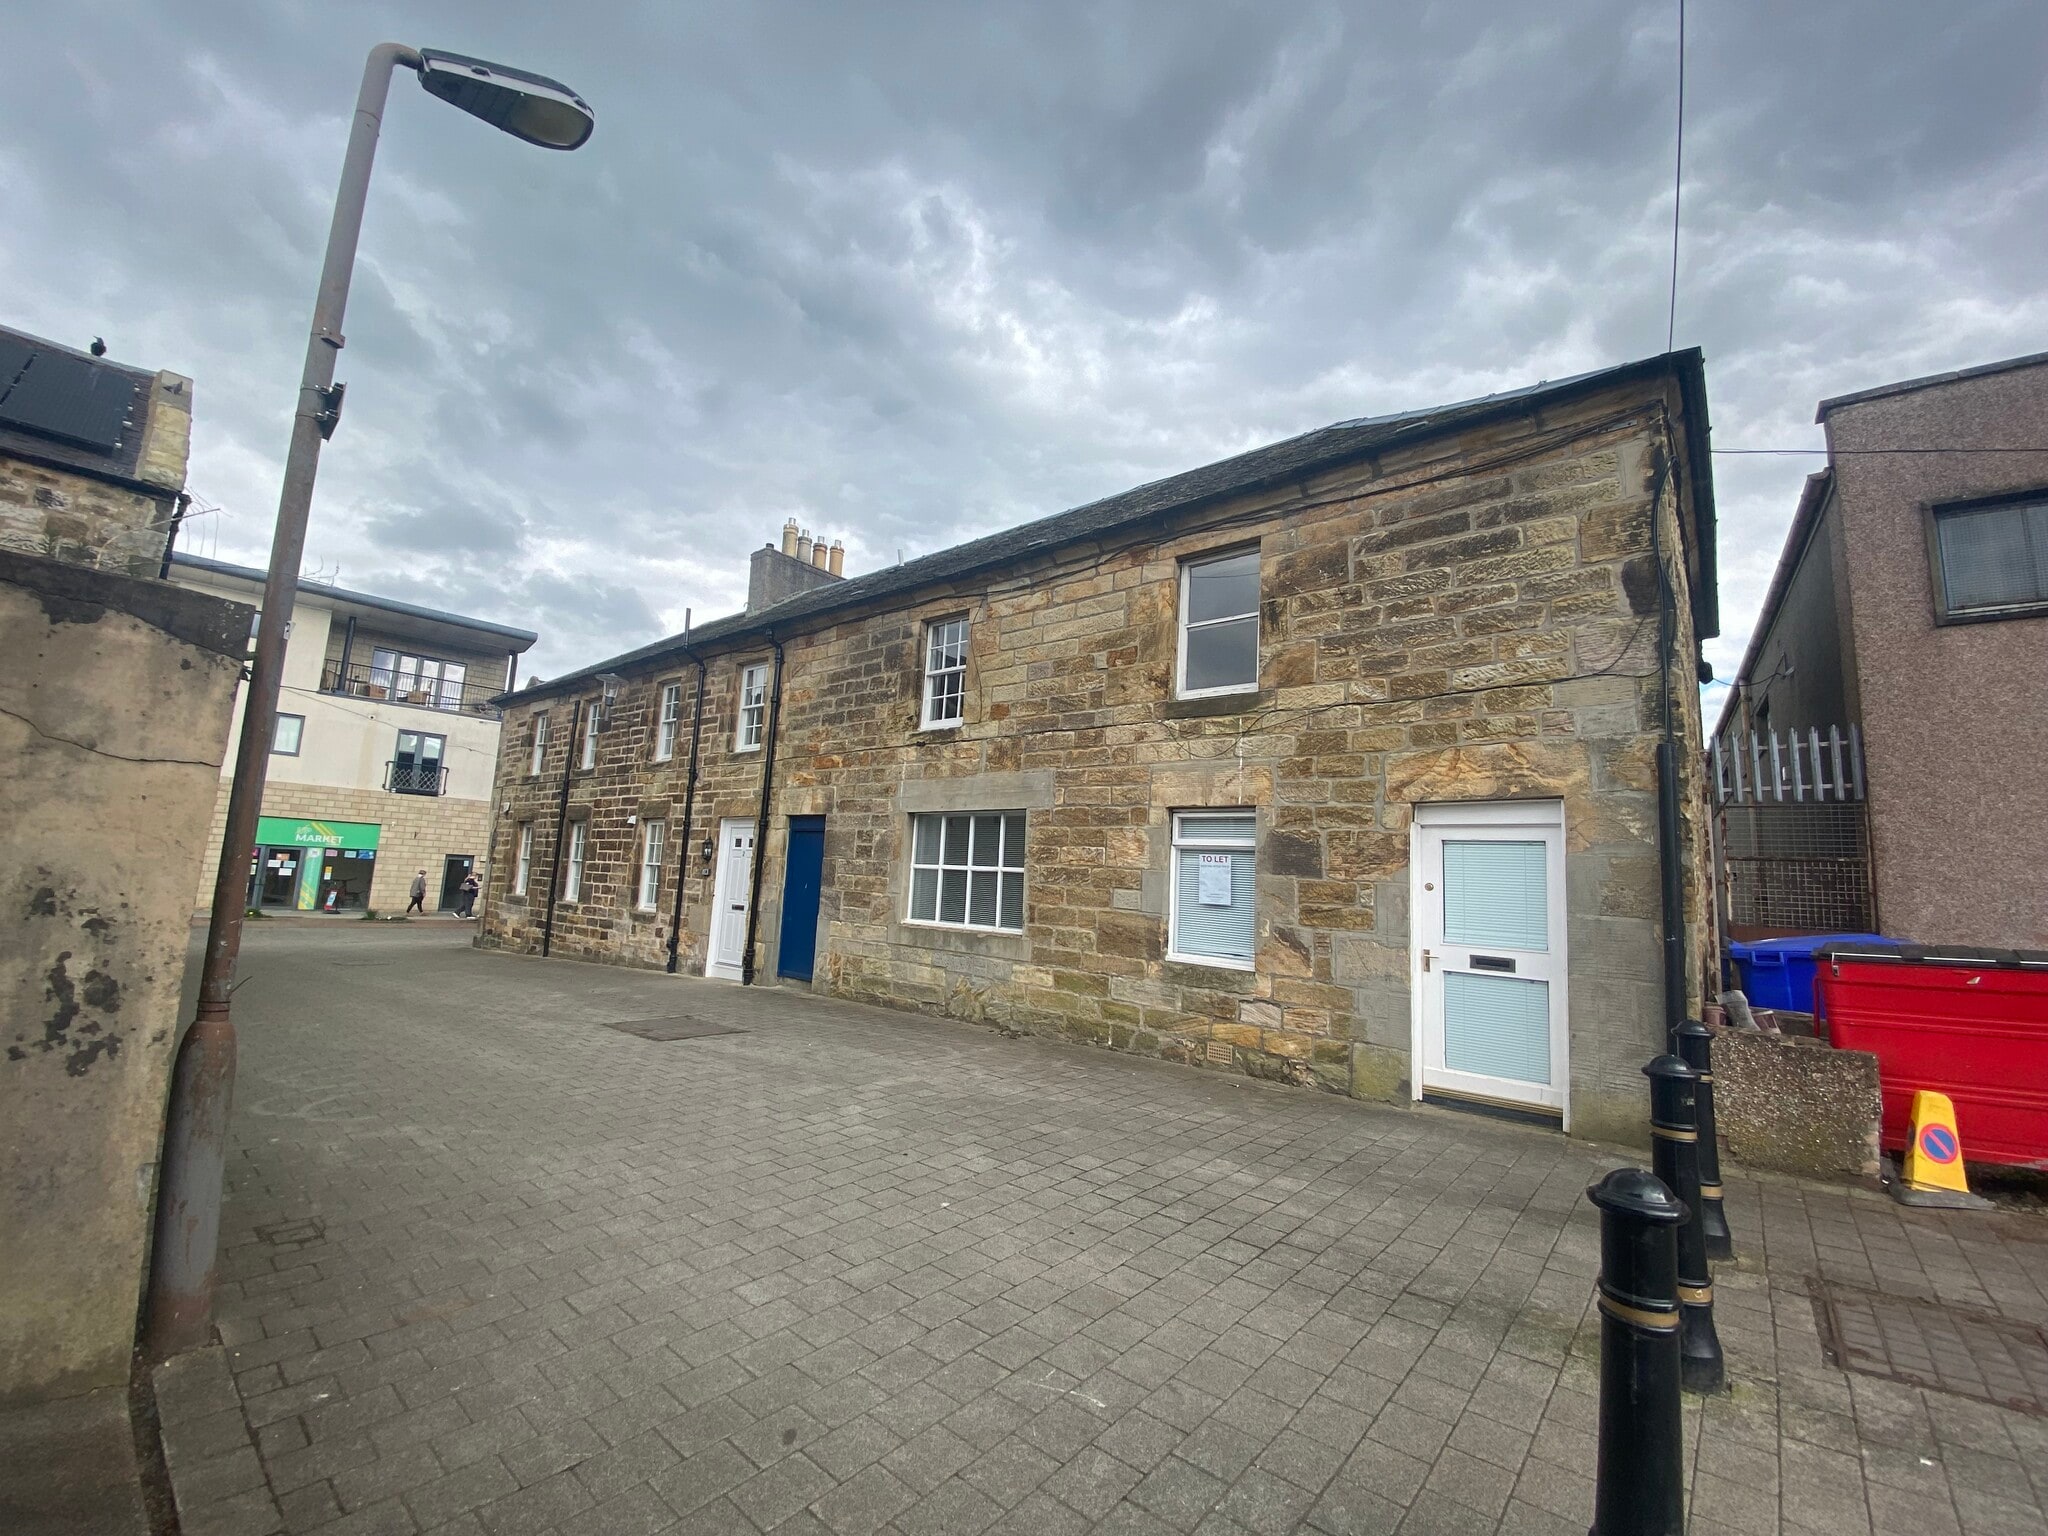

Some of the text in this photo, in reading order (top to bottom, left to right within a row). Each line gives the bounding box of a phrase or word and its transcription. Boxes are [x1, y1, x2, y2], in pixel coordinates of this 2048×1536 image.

[295, 834, 344, 844] MARKET
[1201, 855, 1229, 863] TO LET
